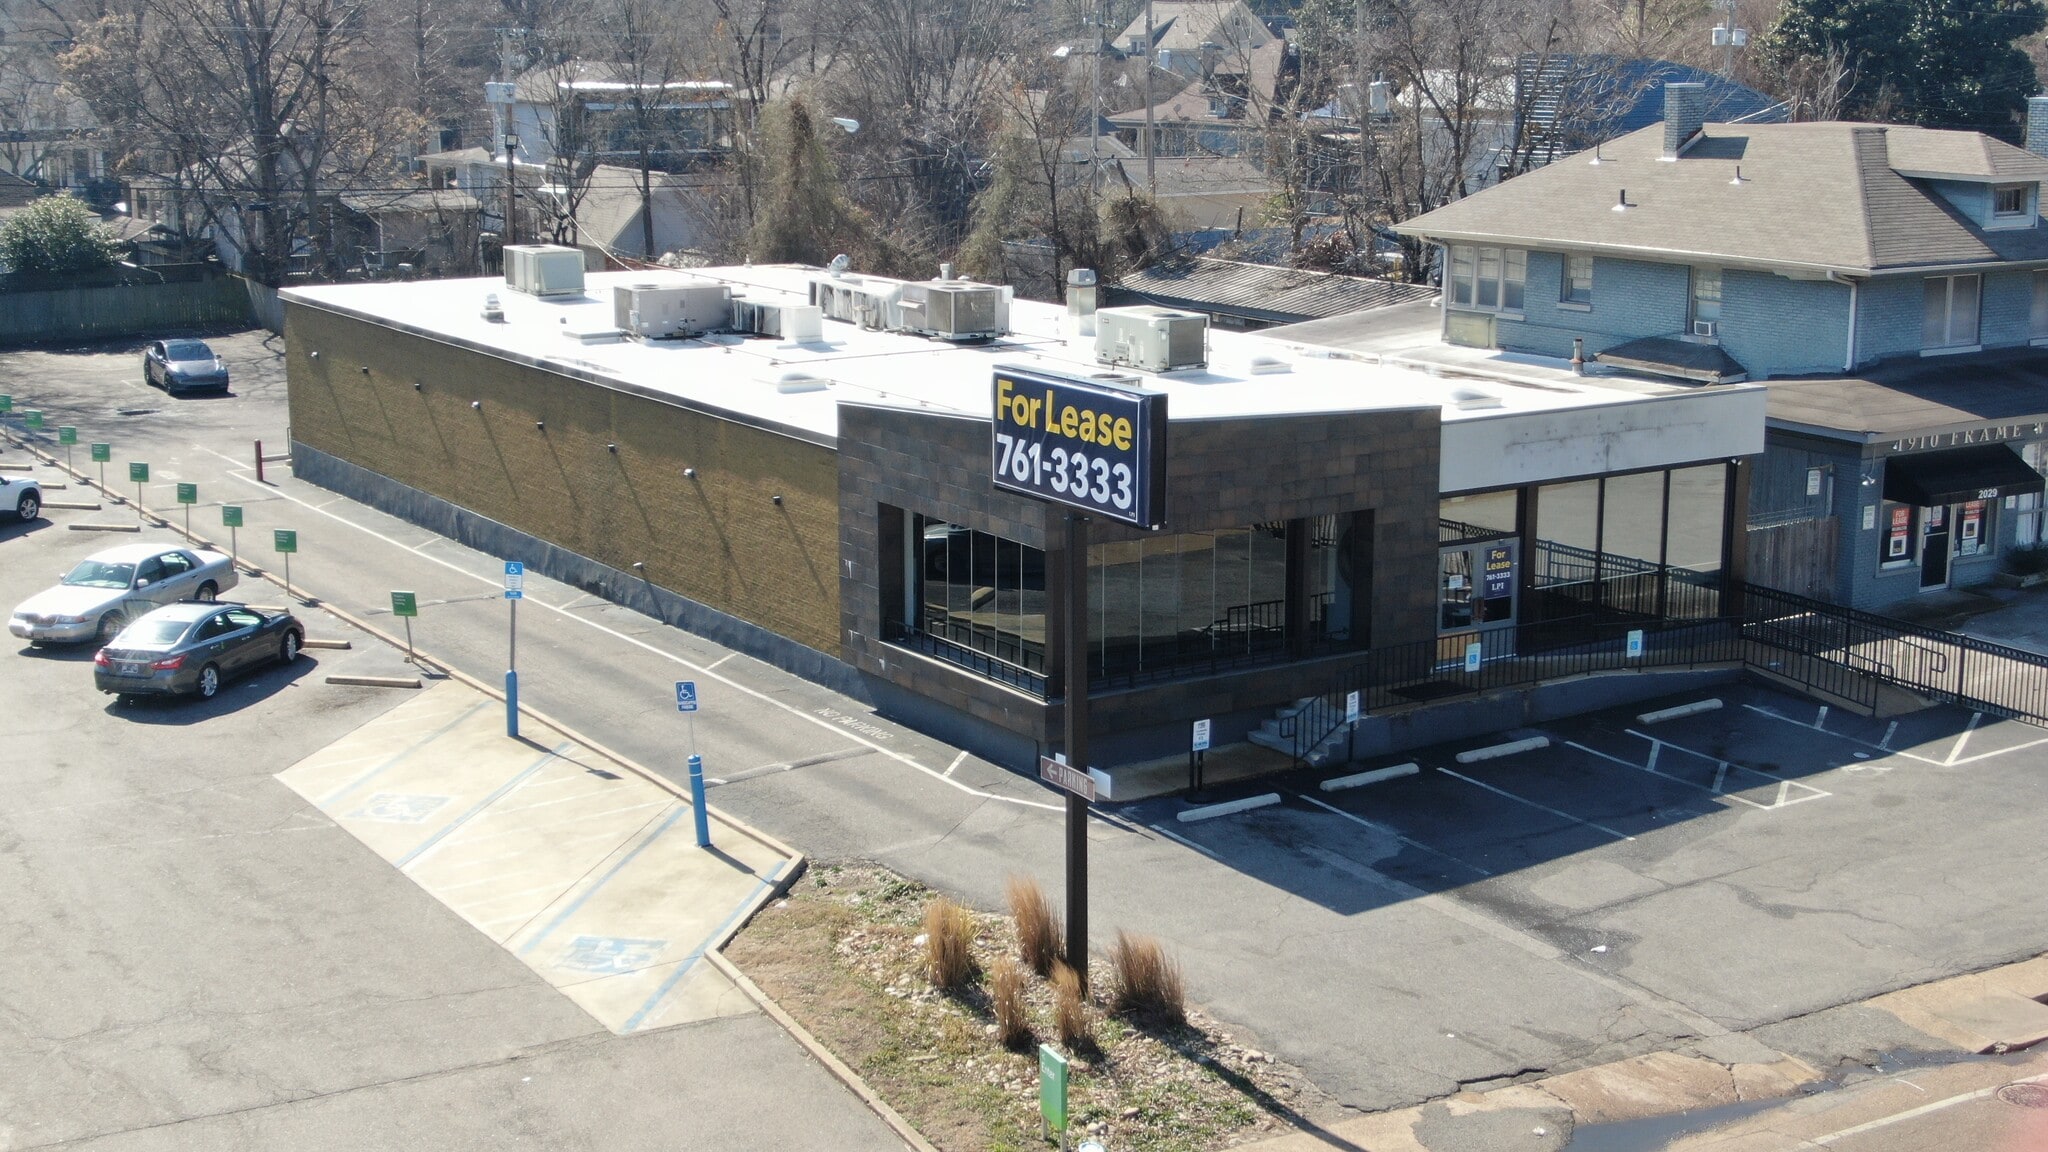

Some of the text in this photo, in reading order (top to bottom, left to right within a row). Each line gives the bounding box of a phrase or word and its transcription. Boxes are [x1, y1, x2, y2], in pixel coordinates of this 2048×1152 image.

[997, 379, 1132, 451] For Lease
[1897, 434, 1939, 452] 1910
[1950, 424, 2022, 446] FRAME
[996, 432, 1132, 510] 761-3333
[1978, 488, 1998, 499] 2029
[1486, 560, 1511, 571] Lease
[1491, 550, 1506, 560] For
[833, 715, 894, 740] PARKING
[1058, 767, 1088, 795] PARKING
